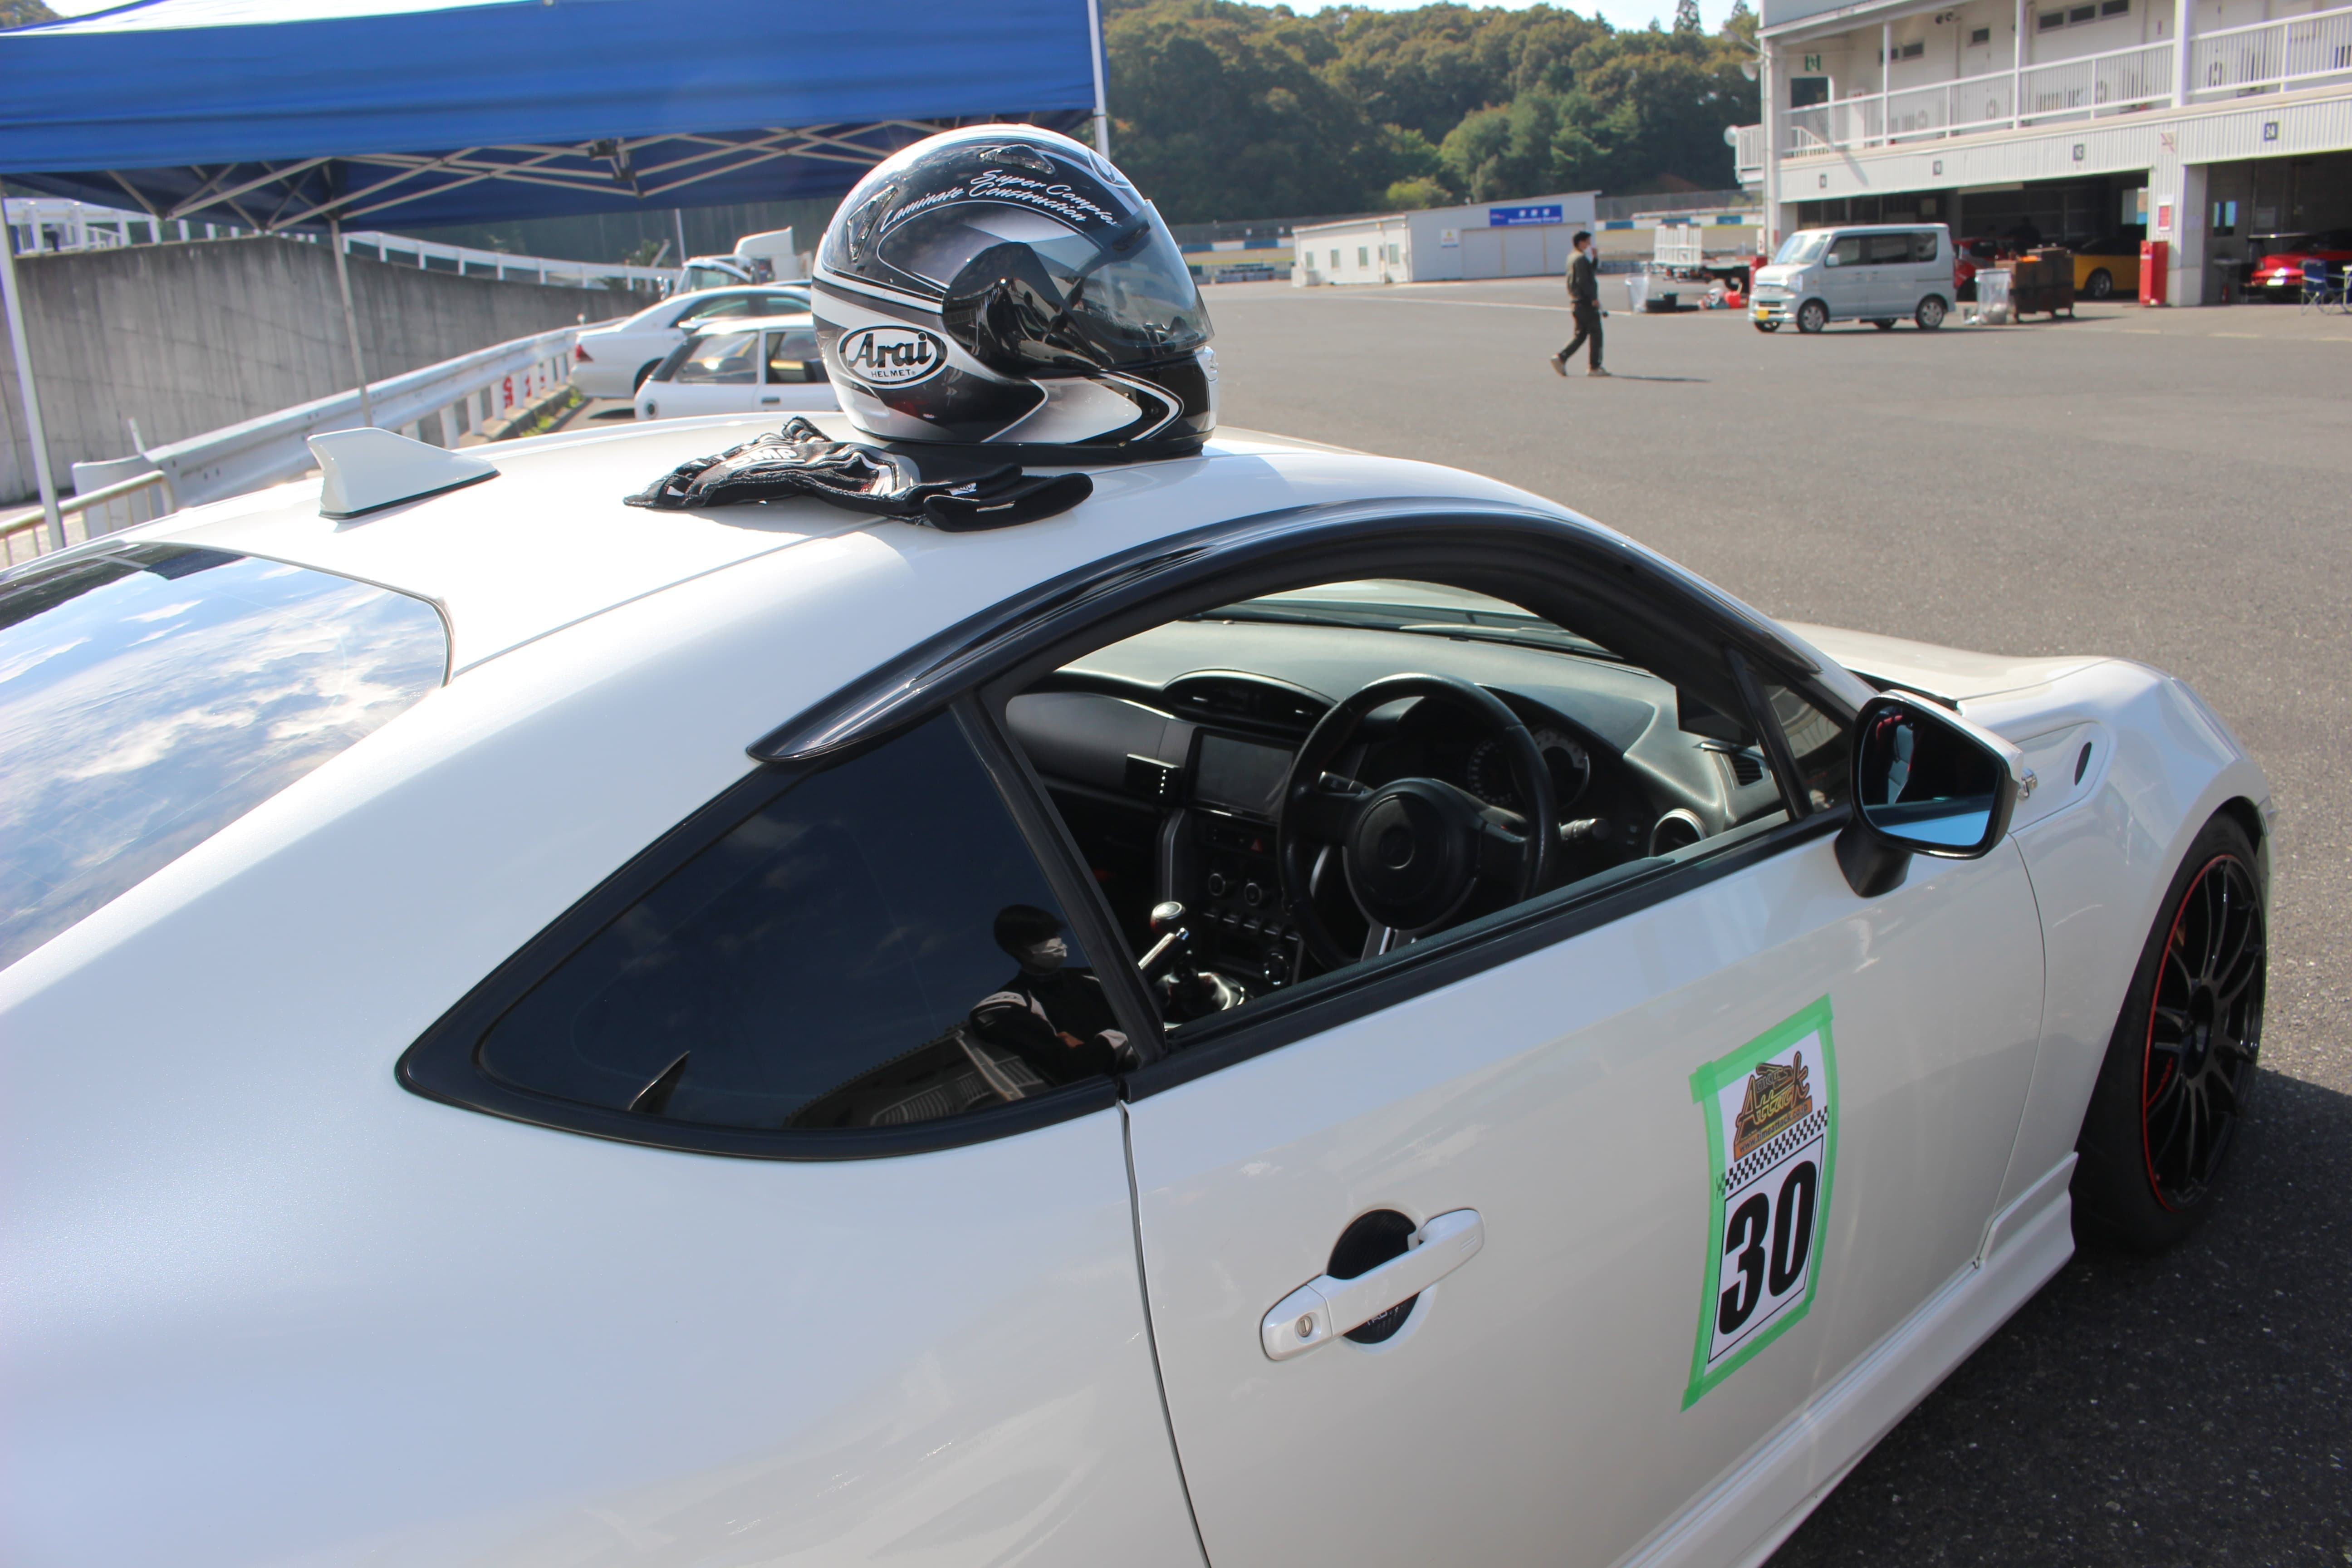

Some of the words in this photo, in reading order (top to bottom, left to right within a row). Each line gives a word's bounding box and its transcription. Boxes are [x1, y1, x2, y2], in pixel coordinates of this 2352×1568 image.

[879, 186, 965, 233] Laminate
[968, 181, 1087, 222] Construction
[970, 169, 1047, 188] Super
[1046, 184, 1121, 227] Complex
[848, 332, 932, 368] Arai
[871, 369, 911, 378] HELMET
[725, 449, 798, 468] OMP
[1735, 1050, 1810, 1145] Attack
[1719, 1160, 1817, 1335] 30
